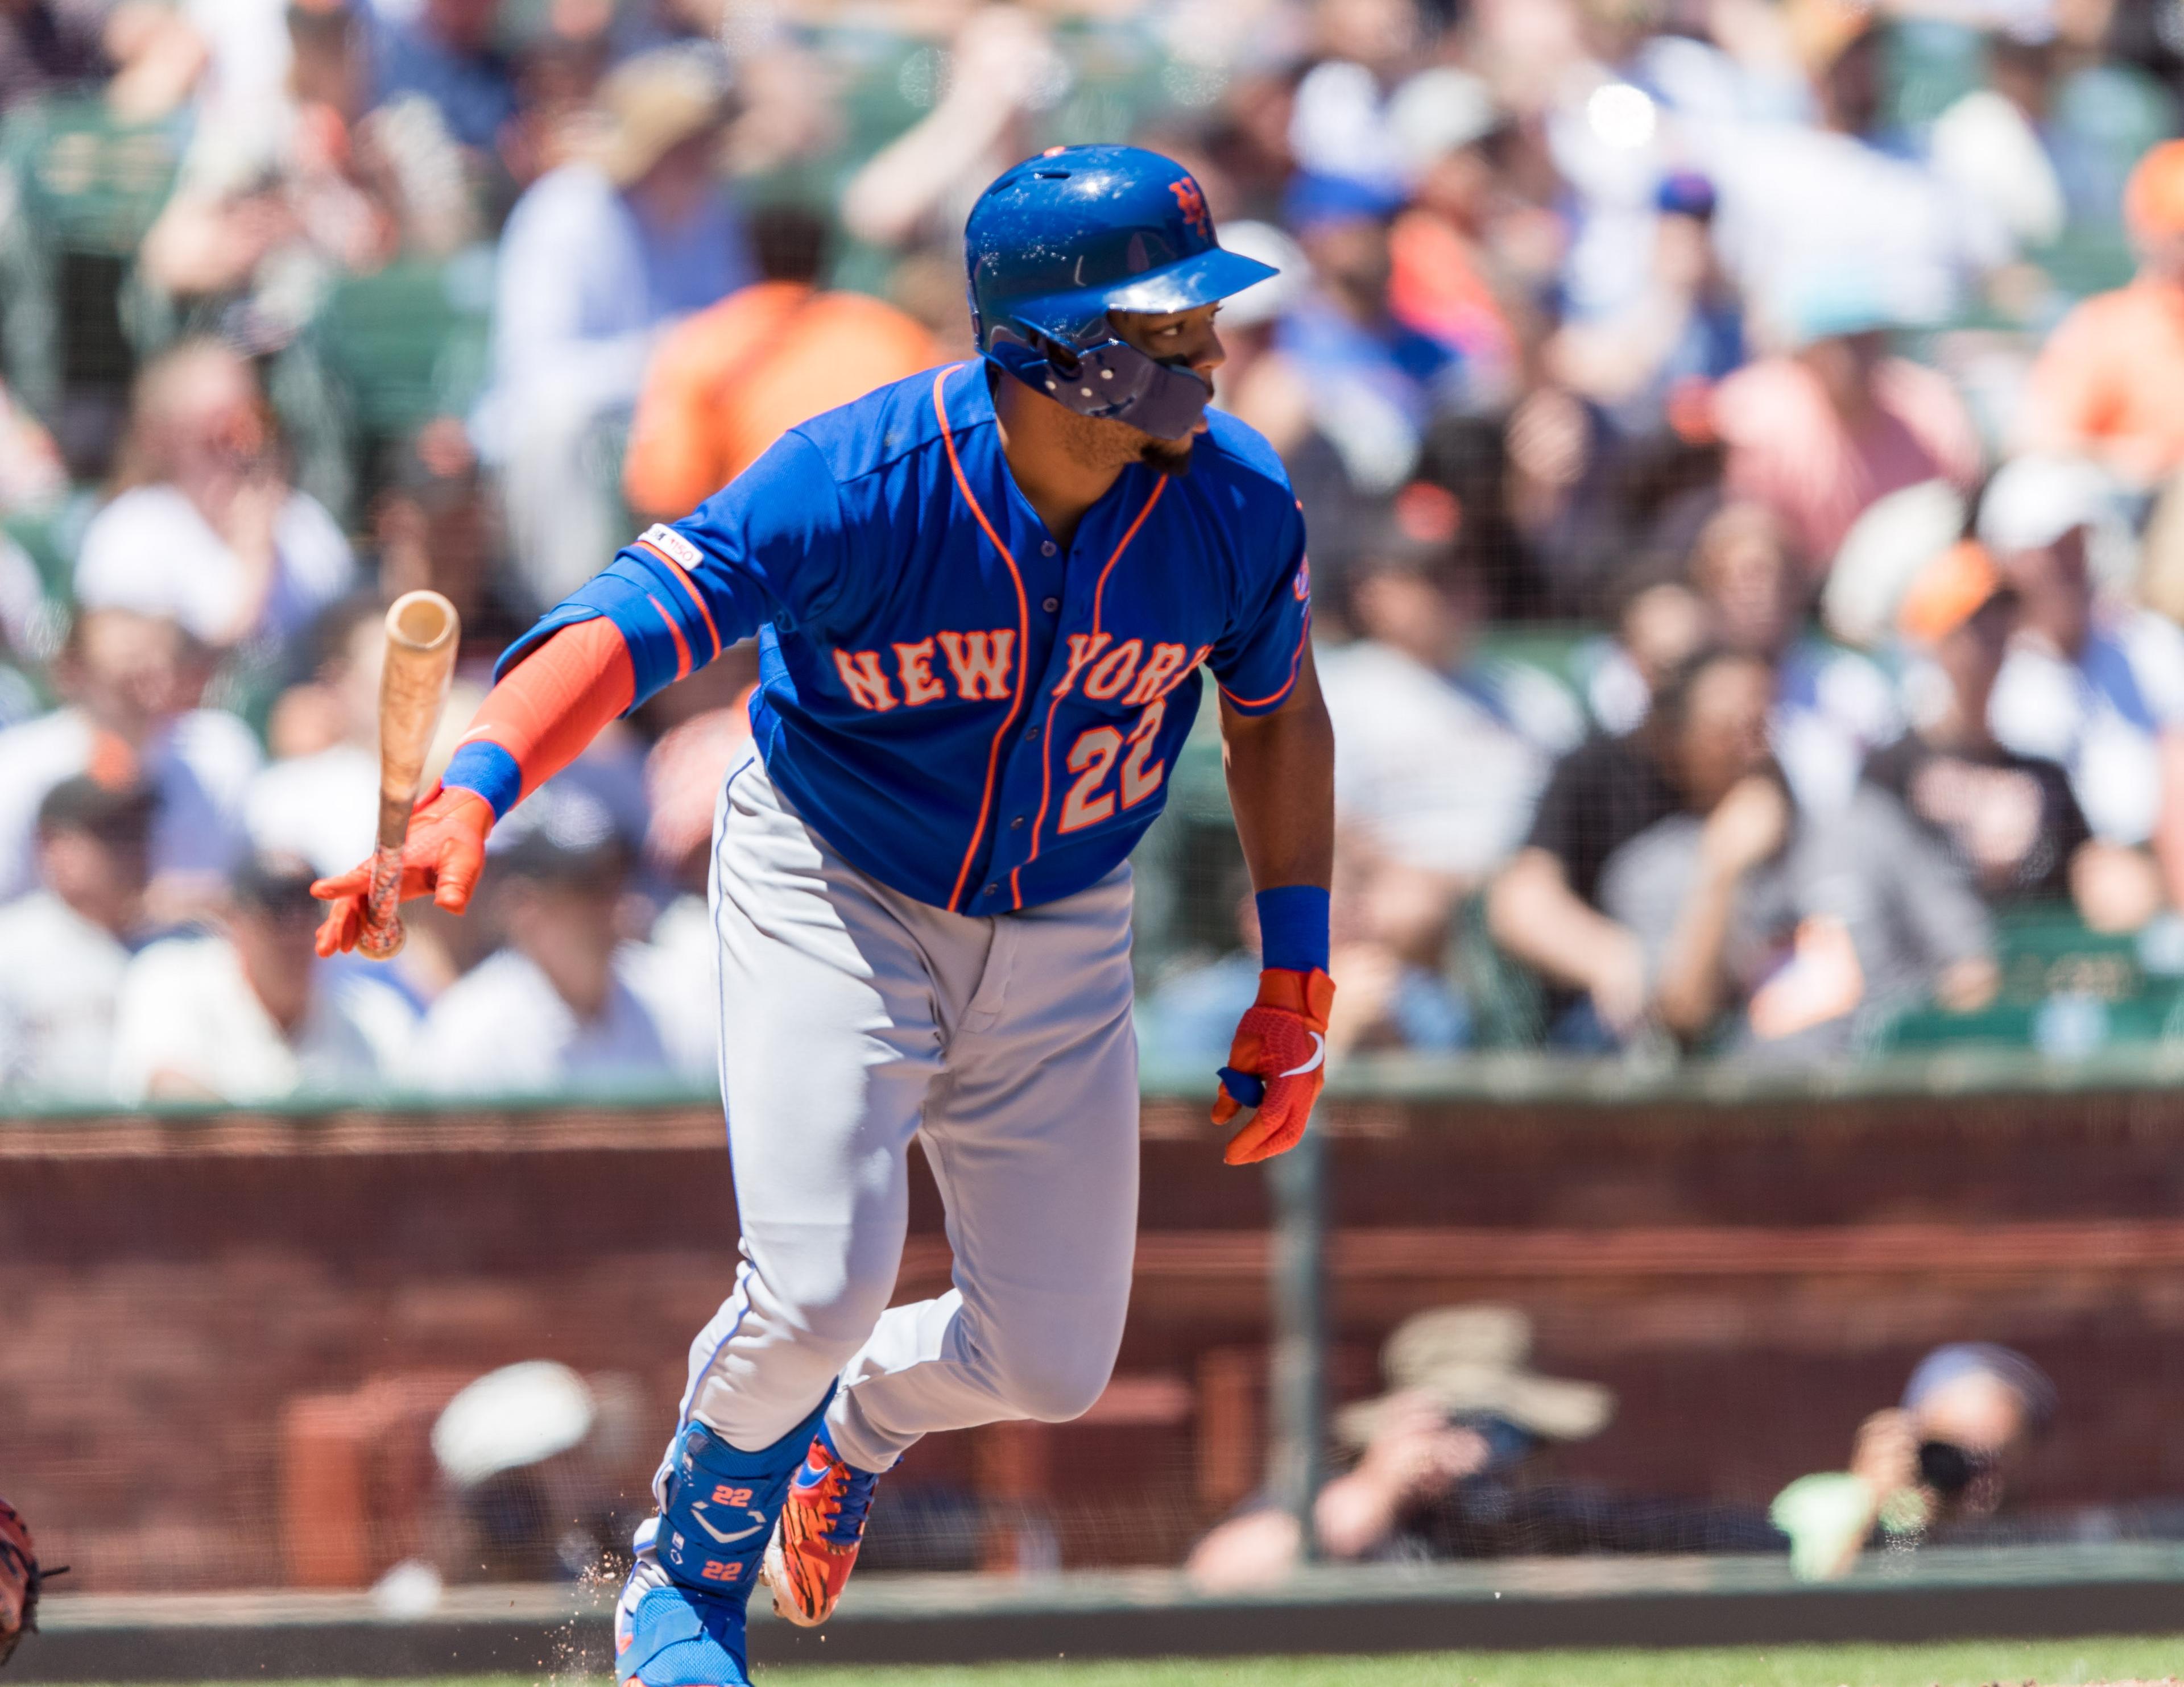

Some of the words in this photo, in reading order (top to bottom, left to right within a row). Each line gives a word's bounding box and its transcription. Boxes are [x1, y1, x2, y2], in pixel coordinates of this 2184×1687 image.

[833, 628, 1016, 712] NEW
[1057, 697, 1167, 835] 22
[712, 1485, 753, 1507] 22
[701, 1560, 743, 1581] 22
